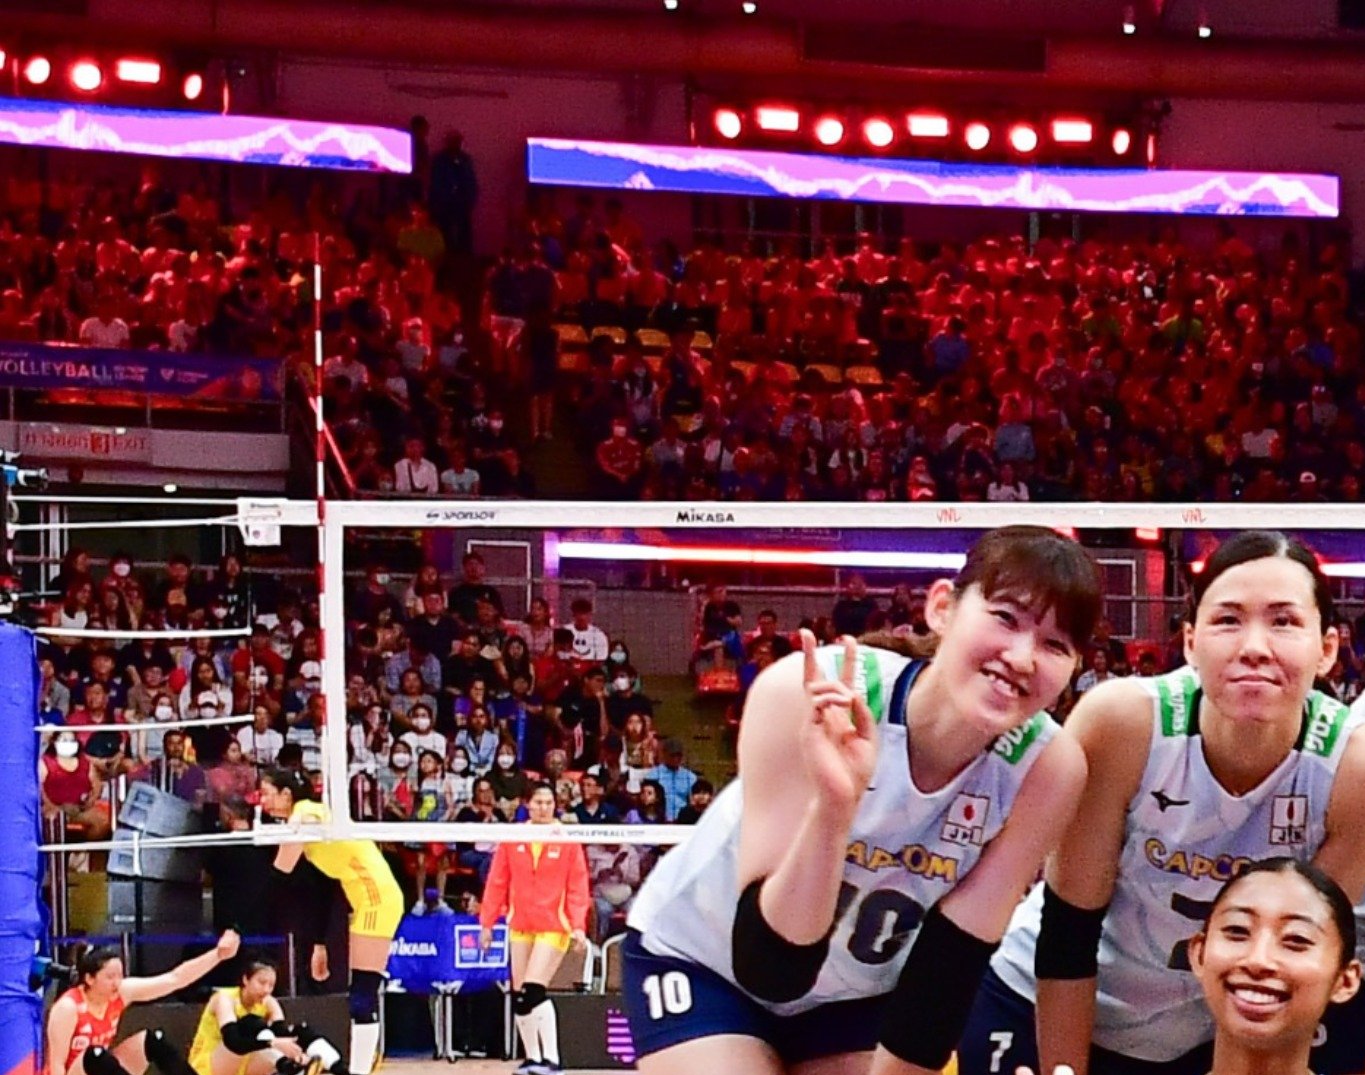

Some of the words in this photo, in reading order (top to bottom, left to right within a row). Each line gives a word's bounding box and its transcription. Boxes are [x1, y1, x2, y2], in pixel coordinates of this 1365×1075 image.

[1145, 837, 1252, 882] CAPC
[643, 971, 693, 1019] 10
[989, 1032, 1014, 1072] 7
